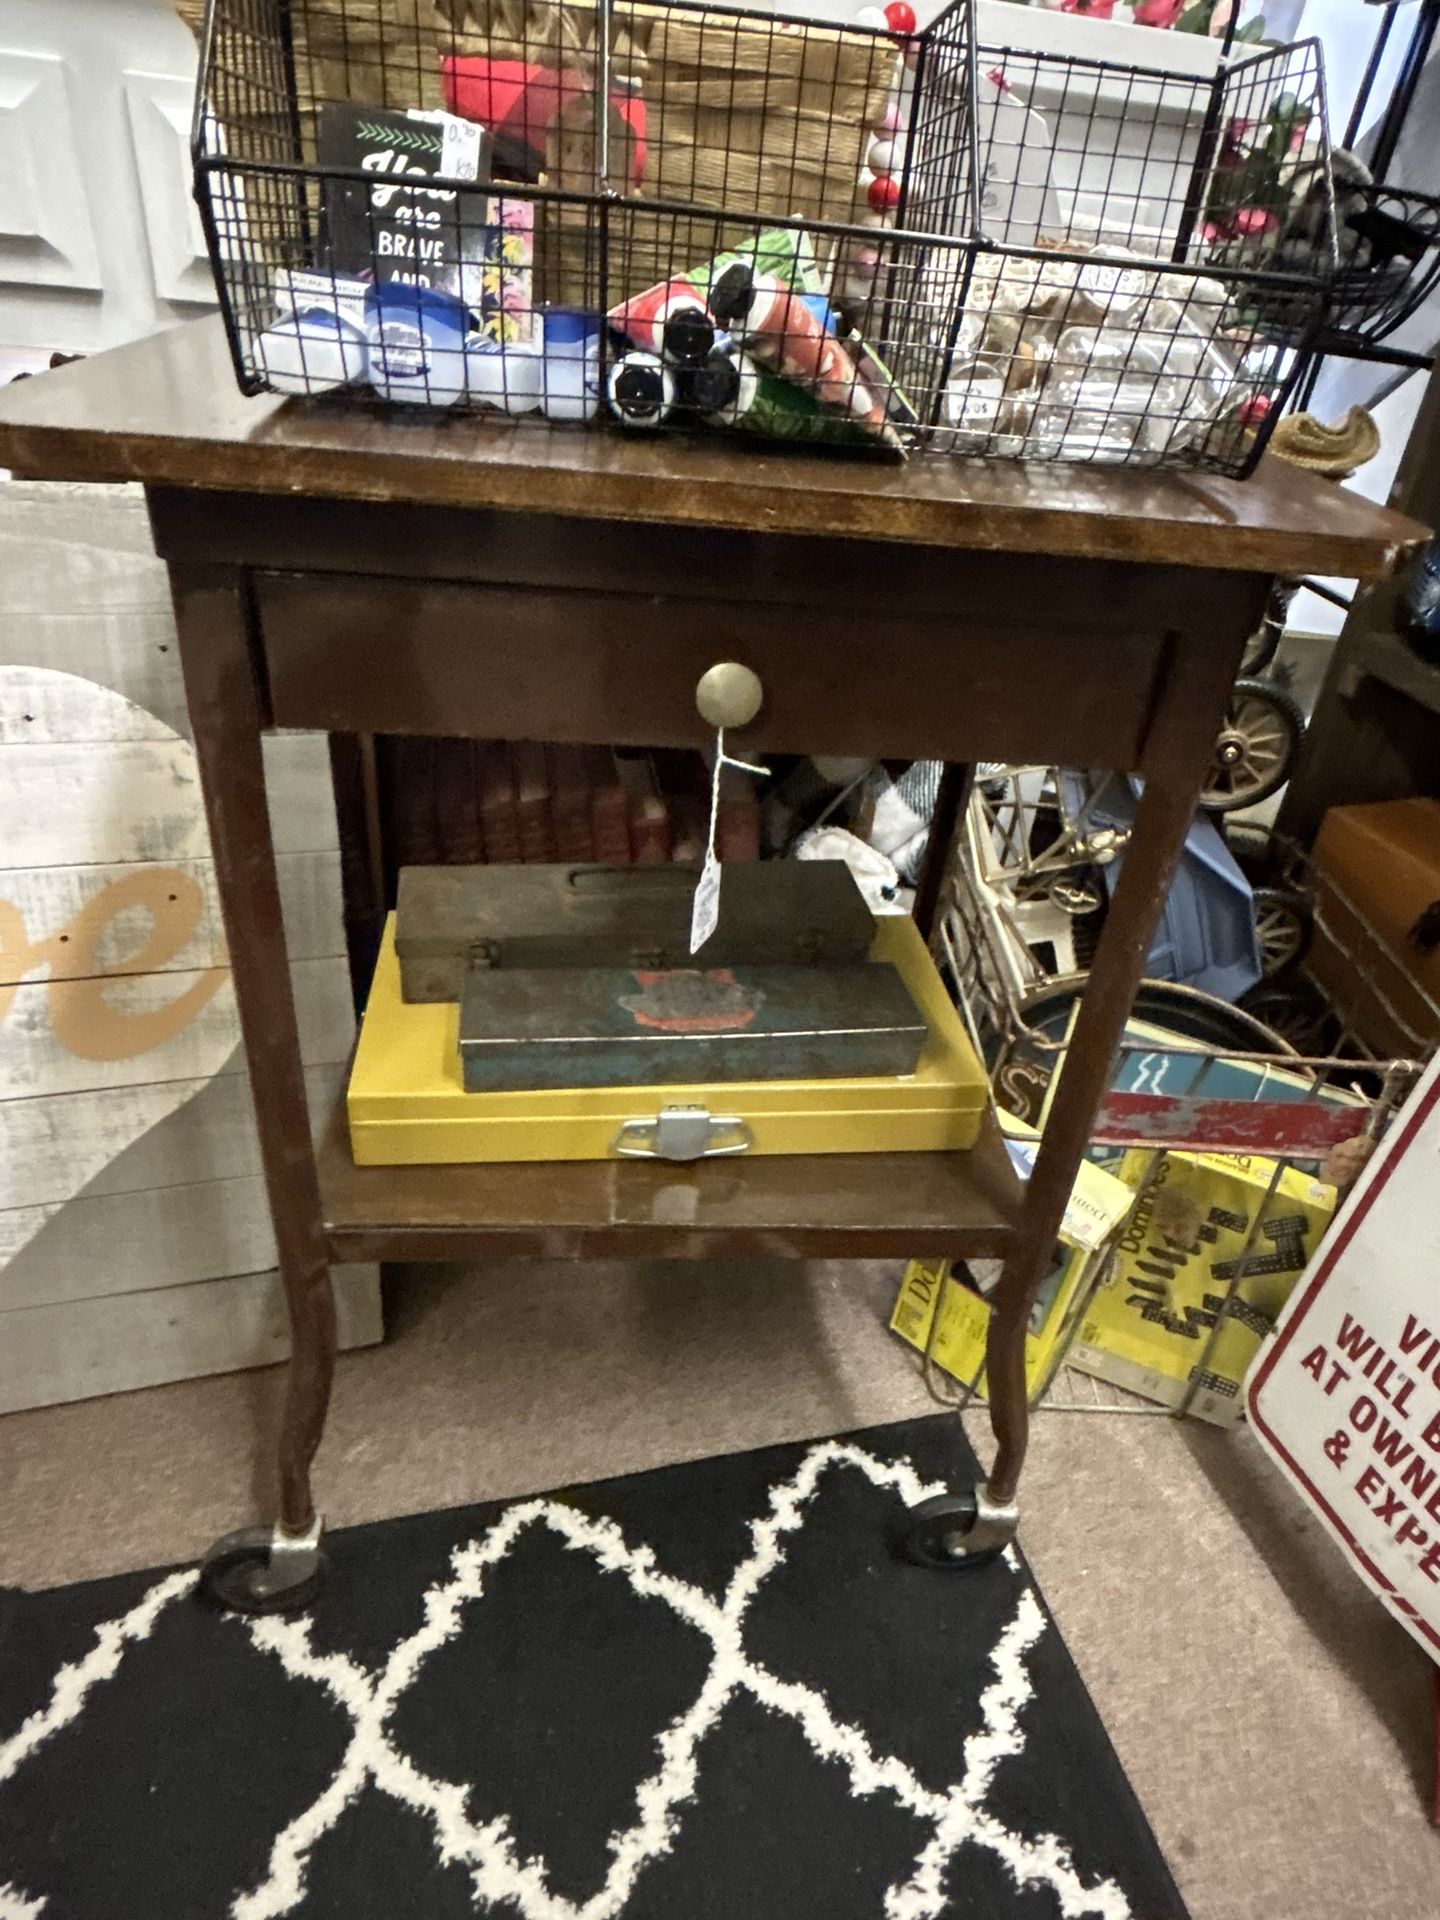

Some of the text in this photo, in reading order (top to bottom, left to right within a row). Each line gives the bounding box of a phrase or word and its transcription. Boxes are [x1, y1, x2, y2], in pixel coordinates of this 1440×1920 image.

[394, 206, 441, 230] are
[377, 231, 445, 266] BRAVE
[390, 269, 430, 288] AND
[1300, 1344, 1351, 1396] AT
[1336, 1312, 1416, 1420] WILL
[1398, 1313, 1440, 1391] VI
[1323, 1430, 1350, 1471] &
